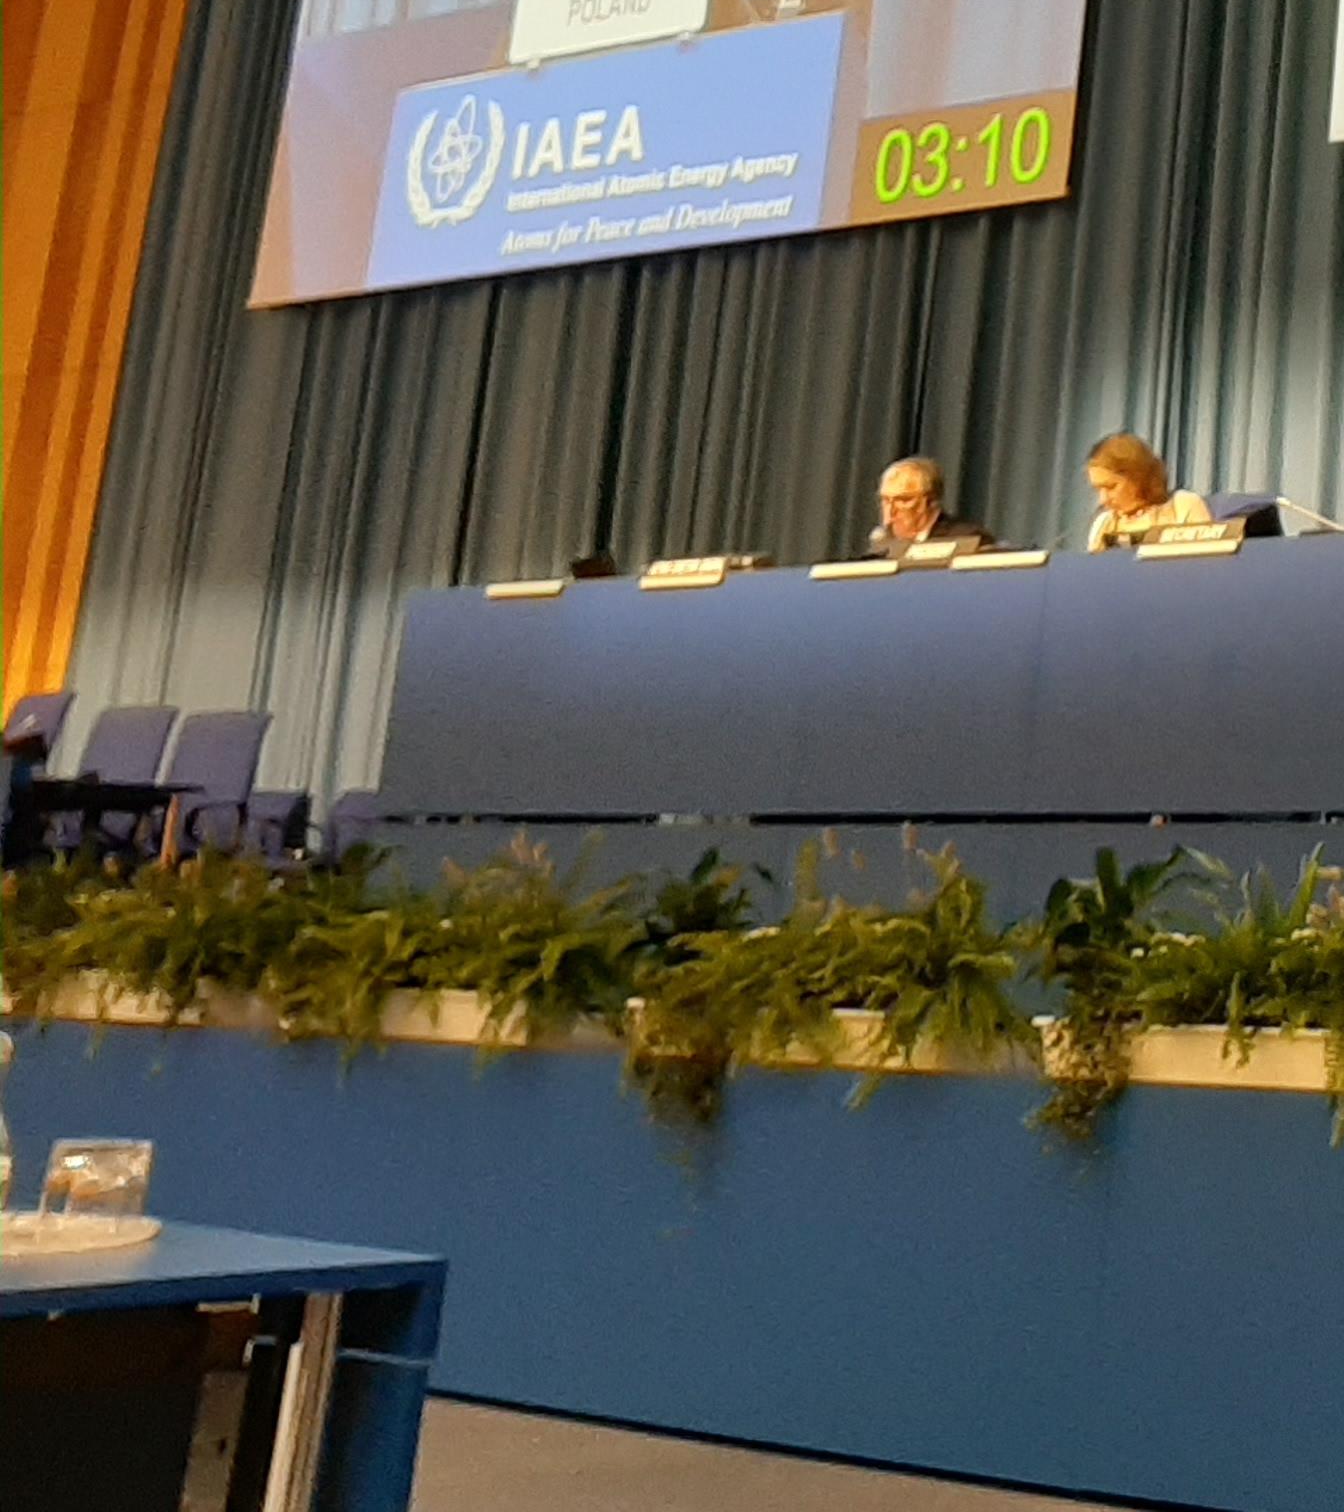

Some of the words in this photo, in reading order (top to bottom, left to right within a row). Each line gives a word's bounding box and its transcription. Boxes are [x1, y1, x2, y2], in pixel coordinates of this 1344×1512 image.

[511, 104, 645, 180] IAEA
[875, 106, 1051, 204] 03:10
[506, 177, 606, 213] International
[607, 169, 666, 197] Atomic
[668, 161, 730, 187] Energy
[731, 151, 799, 184] Agency
[551, 219, 583, 253] for
[585, 215, 635, 243] Peace
[637, 205, 677, 236] and
[674, 194, 794, 229] Development
